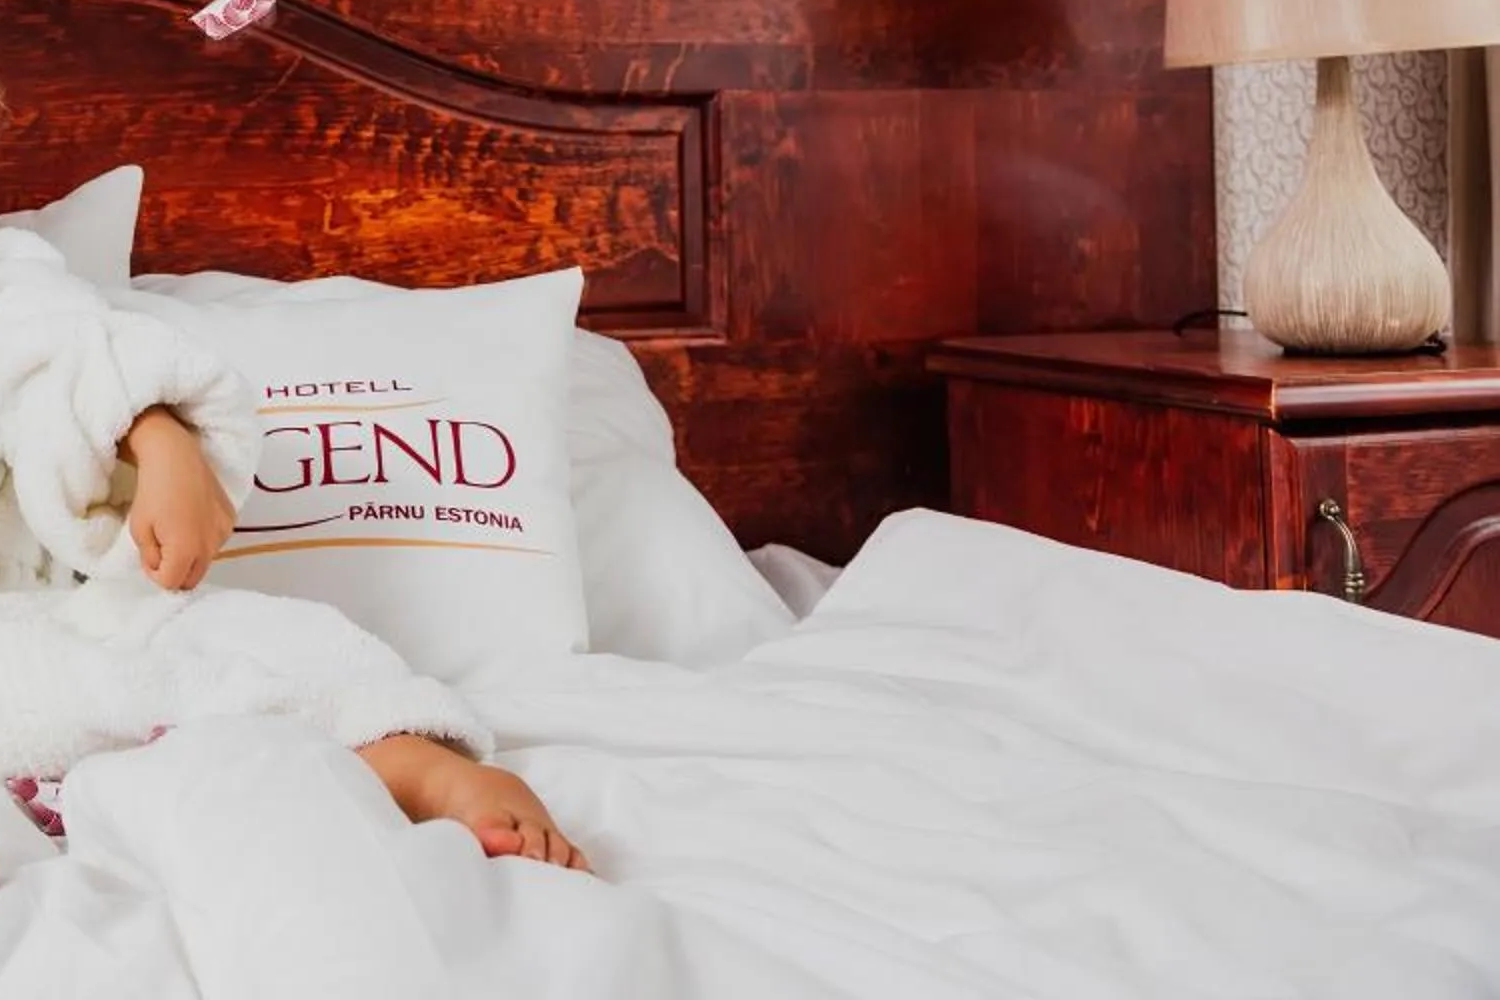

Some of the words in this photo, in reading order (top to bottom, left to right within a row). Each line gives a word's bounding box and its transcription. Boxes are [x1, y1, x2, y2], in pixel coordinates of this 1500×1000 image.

[266, 379, 412, 399] HOTELL
[253, 418, 517, 493] GEND
[348, 502, 426, 521] PÄRNU
[434, 505, 524, 533] ESTONIA
